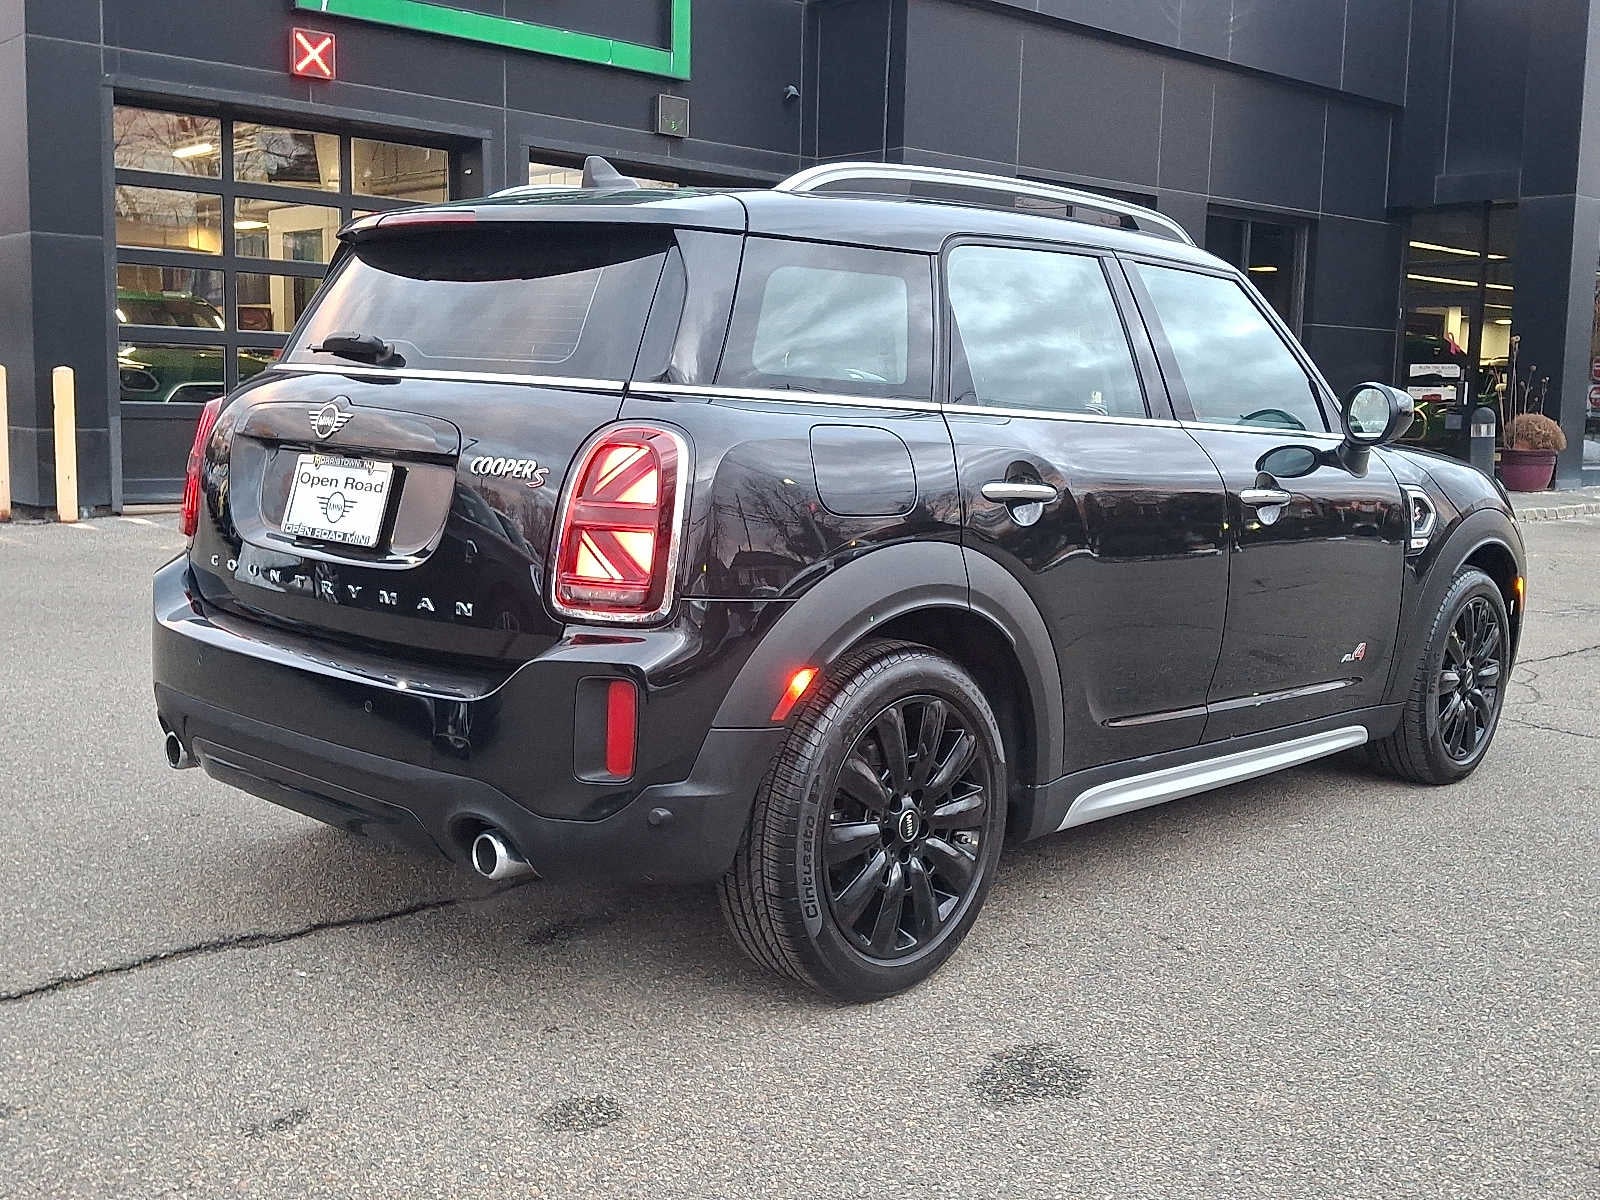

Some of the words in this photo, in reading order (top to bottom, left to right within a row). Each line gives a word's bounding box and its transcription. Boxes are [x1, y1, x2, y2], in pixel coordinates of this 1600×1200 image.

[300, 471, 339, 489] Open
[343, 477, 385, 494] Road
[470, 456, 537, 480] COOPER
[525, 468, 550, 489] S
[285, 523, 315, 537] OPEN
[314, 529, 344, 542] ROAD
[345, 533, 372, 546] MINI
[210, 554, 475, 618] COUNTRYMAN
[802, 815, 819, 919] Cinturato
